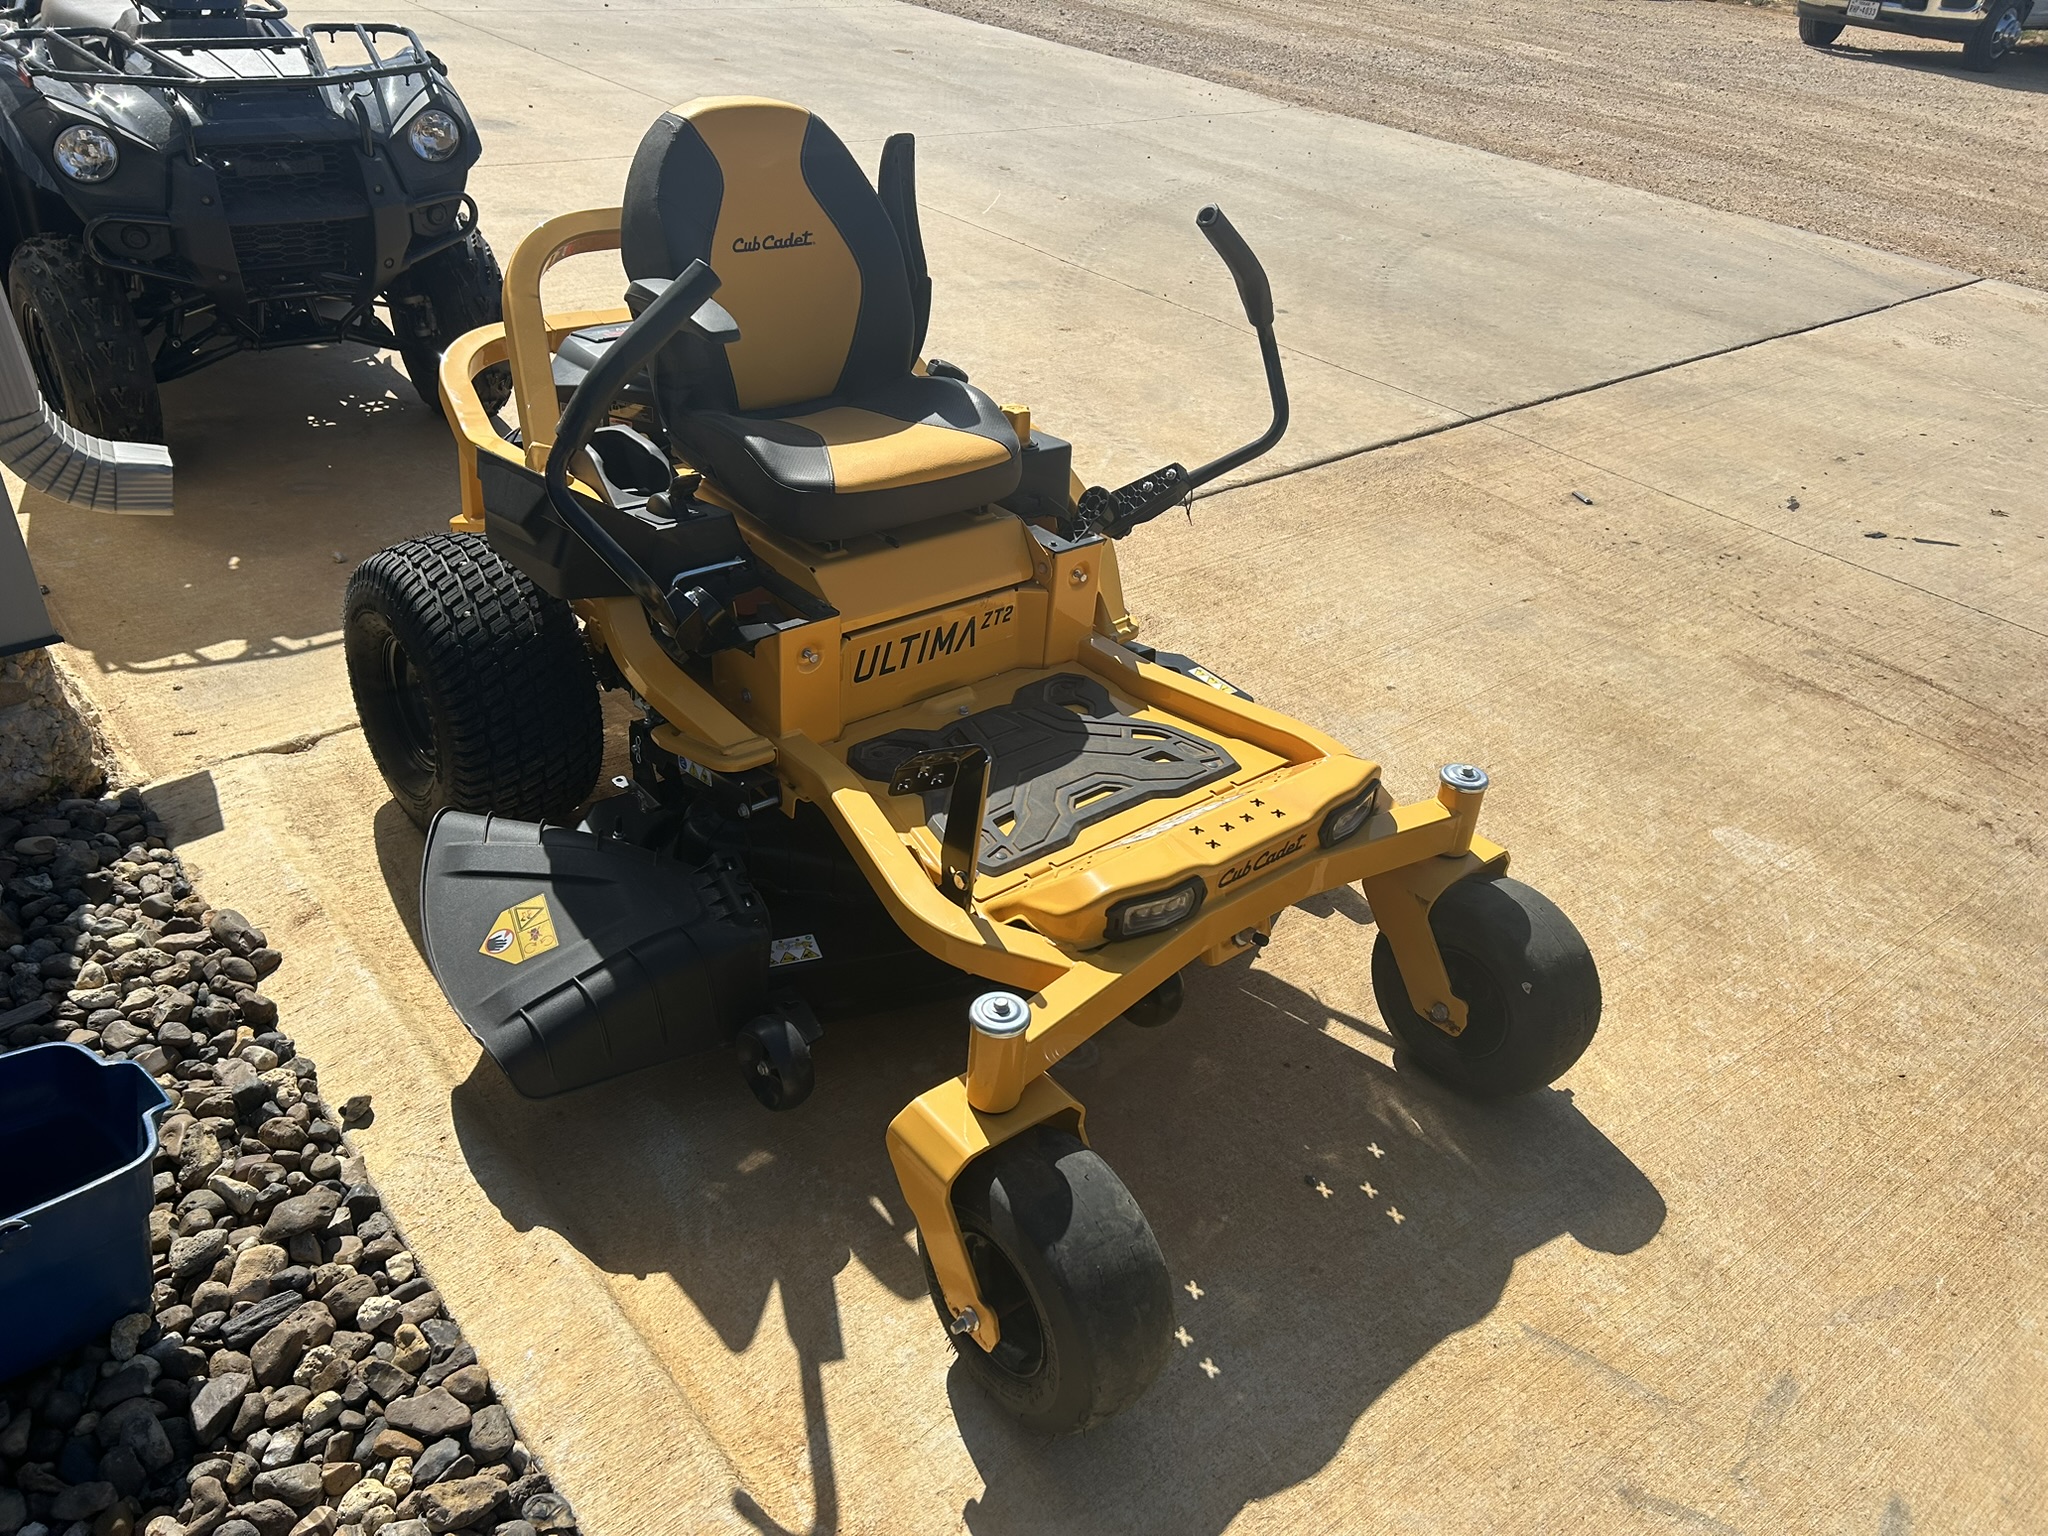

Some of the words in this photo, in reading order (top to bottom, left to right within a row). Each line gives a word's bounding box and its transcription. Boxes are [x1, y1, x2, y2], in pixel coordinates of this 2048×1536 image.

[732, 236, 760, 253] Cub
[762, 231, 813, 250] Cadet
[853, 616, 976, 684] ULTIMA
[980, 605, 1014, 630] ZT2
[1218, 860, 1252, 888] Cub
[1253, 834, 1308, 871] Cadet
